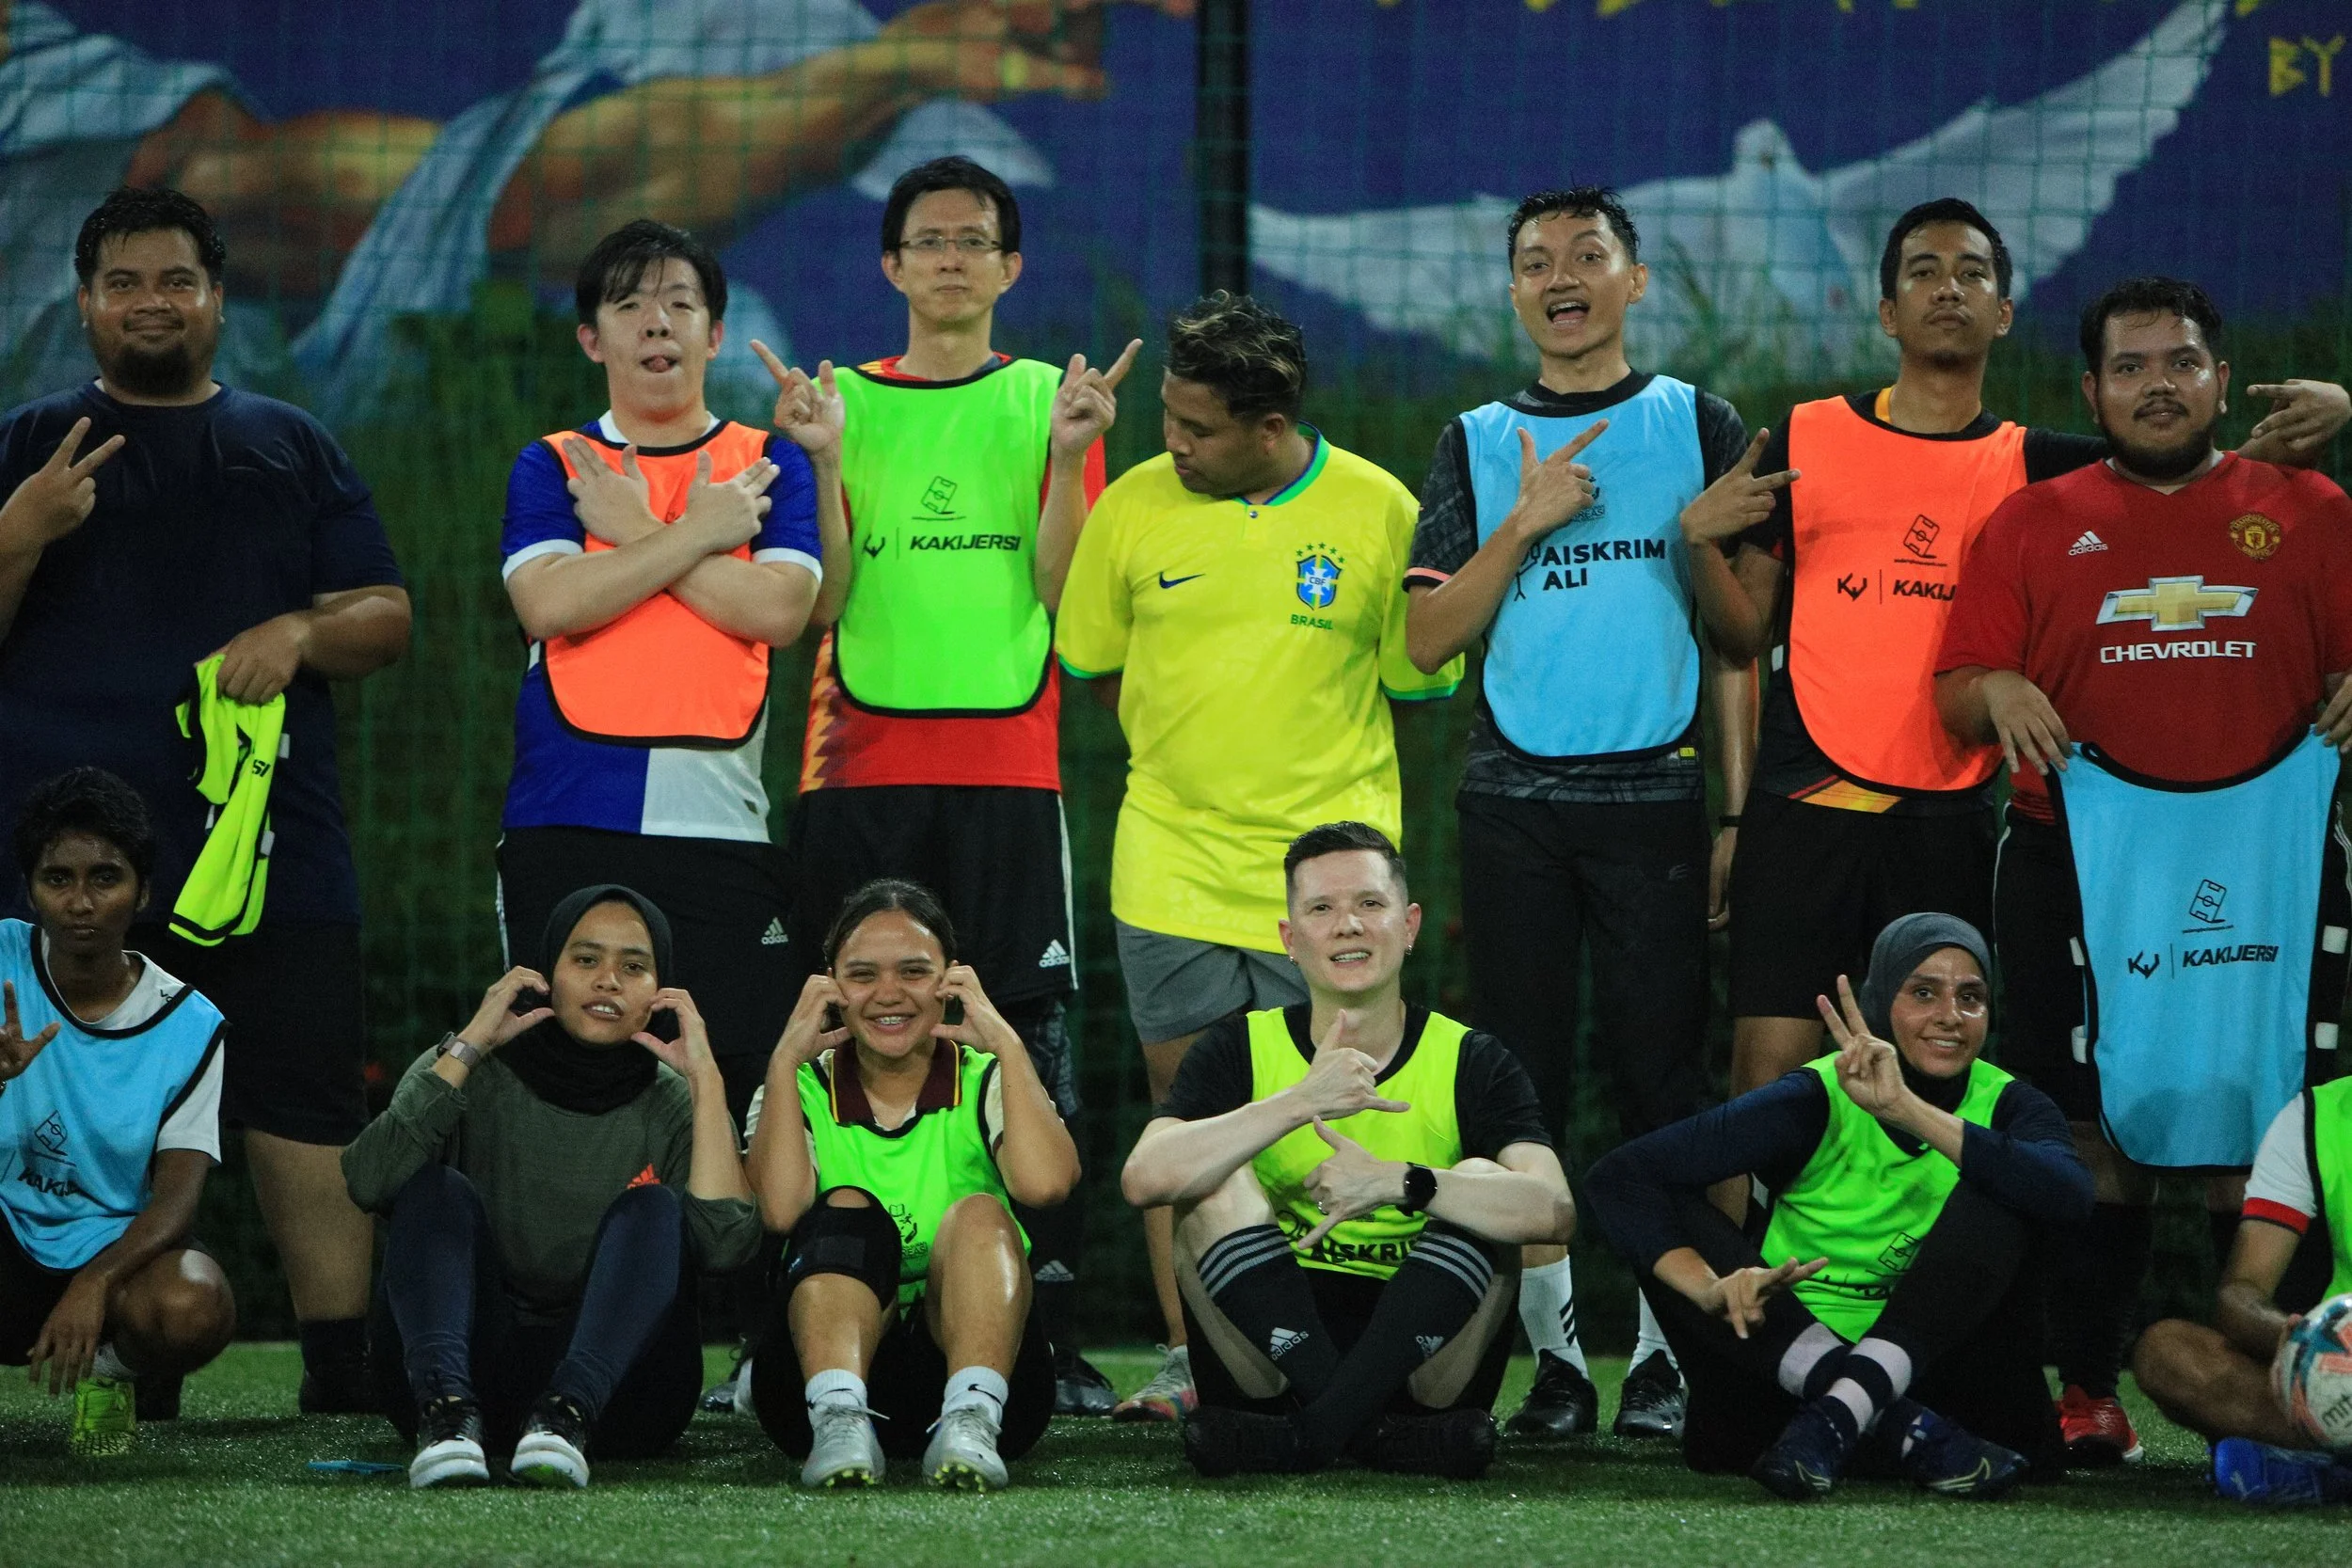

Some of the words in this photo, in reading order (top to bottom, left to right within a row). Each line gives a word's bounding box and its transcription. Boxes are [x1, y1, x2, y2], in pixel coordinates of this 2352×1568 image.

[2269, 34, 2345, 96] BY
[910, 534, 1022, 551] KAKIJERSI
[1541, 539, 1665, 566] AISKRIM
[2068, 543, 2108, 556] adidas
[1543, 567, 1588, 591] ALI
[1893, 579, 1958, 601] KAKIJ
[1290, 614, 1334, 630] BRASIL
[2100, 641, 2258, 664] CHEVROLET
[2183, 944, 2279, 968] KAKIJERSI
[1272, 1330, 1309, 1361] adidas
